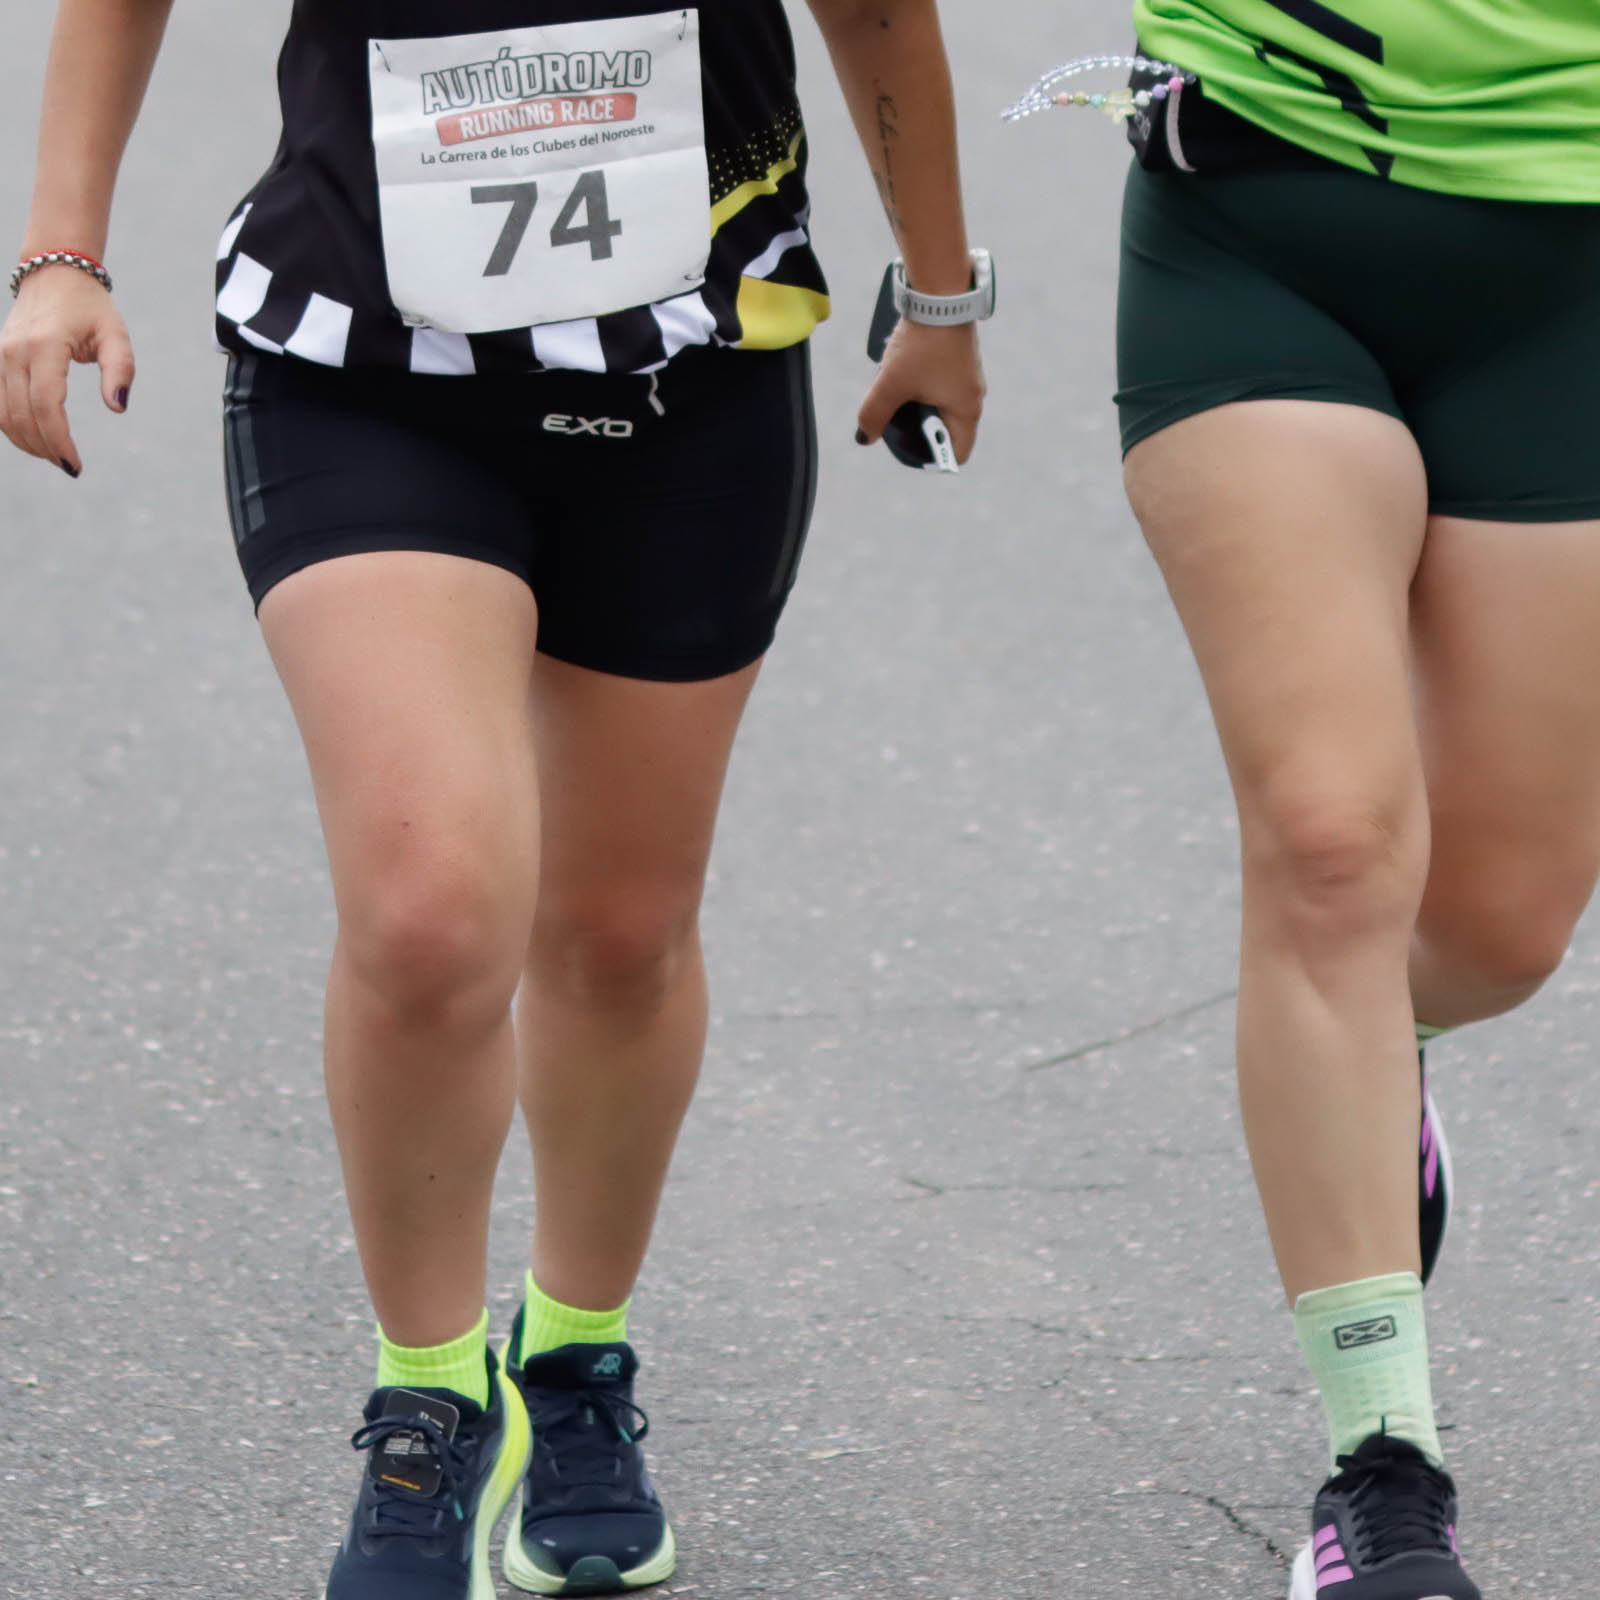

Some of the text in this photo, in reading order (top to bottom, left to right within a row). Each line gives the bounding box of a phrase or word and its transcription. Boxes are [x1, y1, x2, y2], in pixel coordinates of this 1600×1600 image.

[420, 46, 652, 116] AUTÓDROMO
[459, 97, 615, 141] RUNNING RACE
[420, 123, 655, 165] La Carrera de los Clubes del Noroeste
[470, 169, 623, 278] 74
[542, 413, 634, 438] EXO
